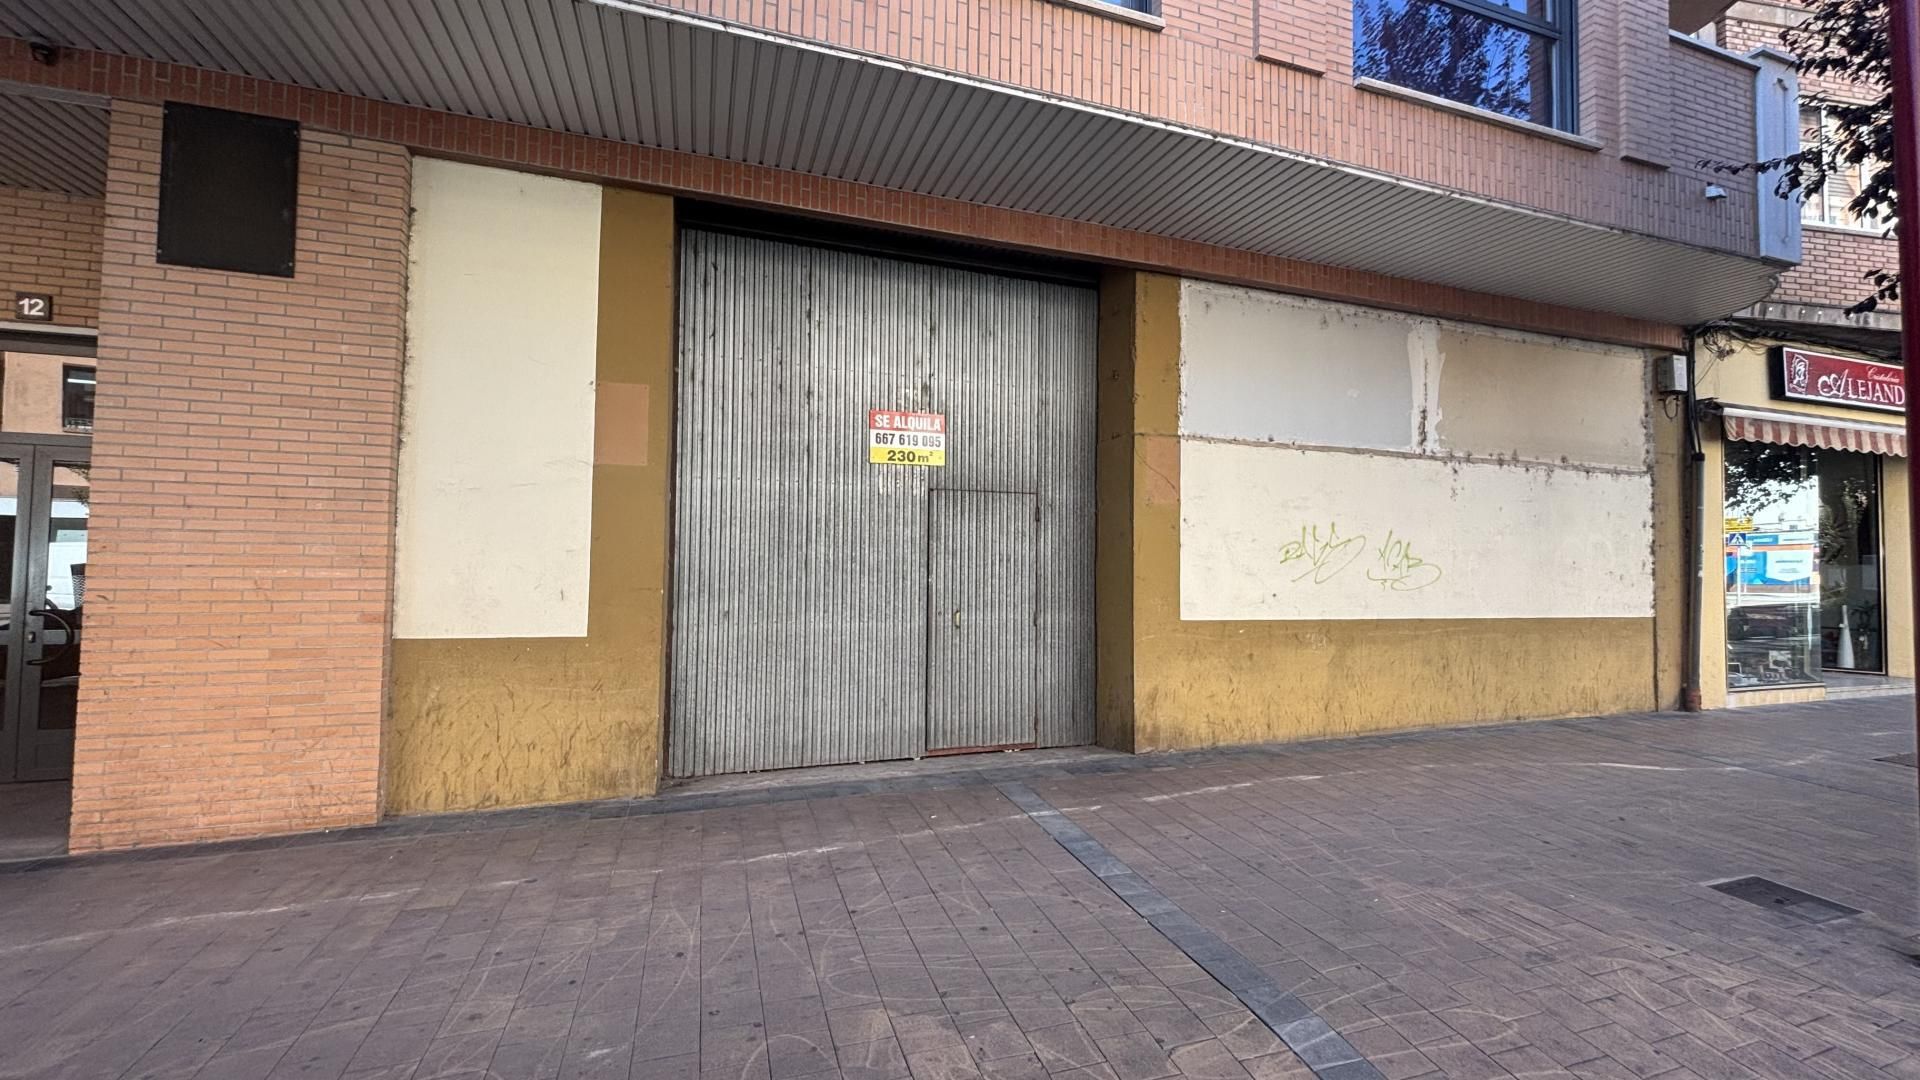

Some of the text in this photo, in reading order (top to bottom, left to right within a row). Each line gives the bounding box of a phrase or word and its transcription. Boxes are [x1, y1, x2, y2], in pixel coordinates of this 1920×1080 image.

[18, 297, 45, 316] 12
[875, 414, 941, 431] SE ALQUILA
[875, 432, 941, 448] 667 619 095
[887, 449, 916, 462] 230
